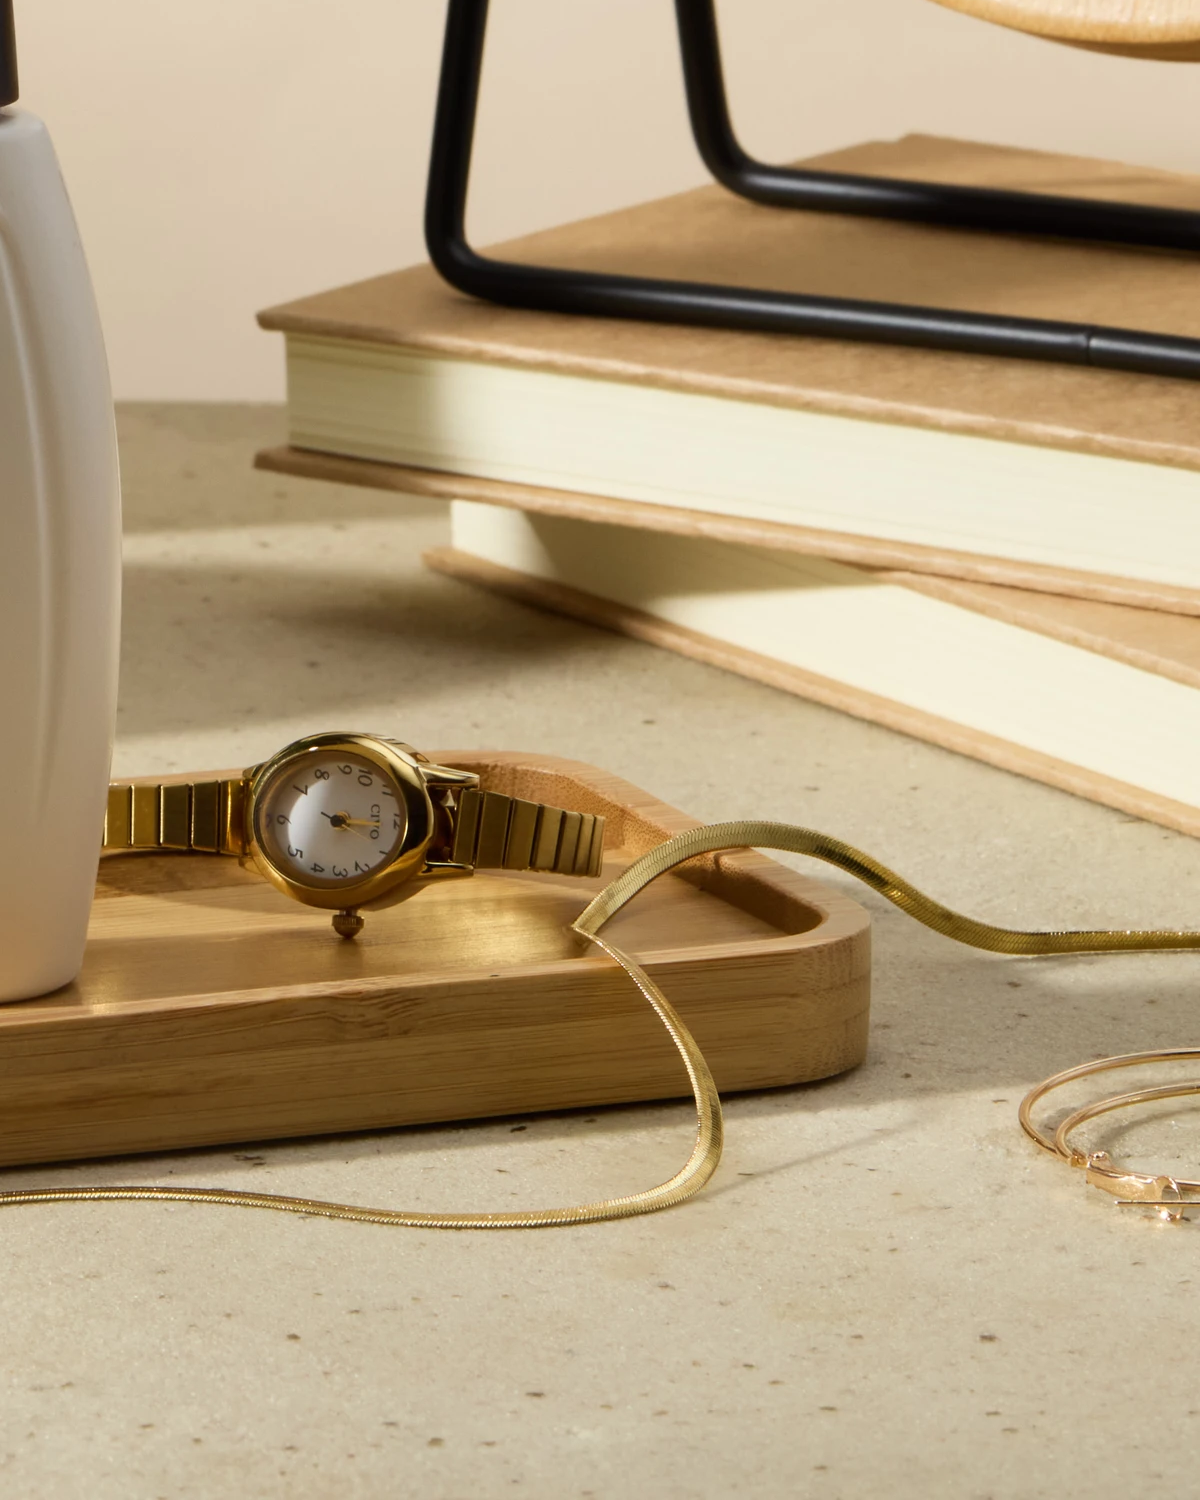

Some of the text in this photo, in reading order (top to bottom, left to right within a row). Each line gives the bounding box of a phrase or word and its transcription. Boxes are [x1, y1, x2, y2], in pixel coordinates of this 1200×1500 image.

[314, 768, 330, 780] 8
[336, 764, 353, 775] 9
[357, 768, 374, 787] 10
[292, 784, 309, 796] 7
[276, 814, 292, 826] 6
[287, 844, 304, 859] 5
[309, 862, 326, 874] 4
[332, 864, 349, 878] 3
[354, 860, 371, 873] 2
